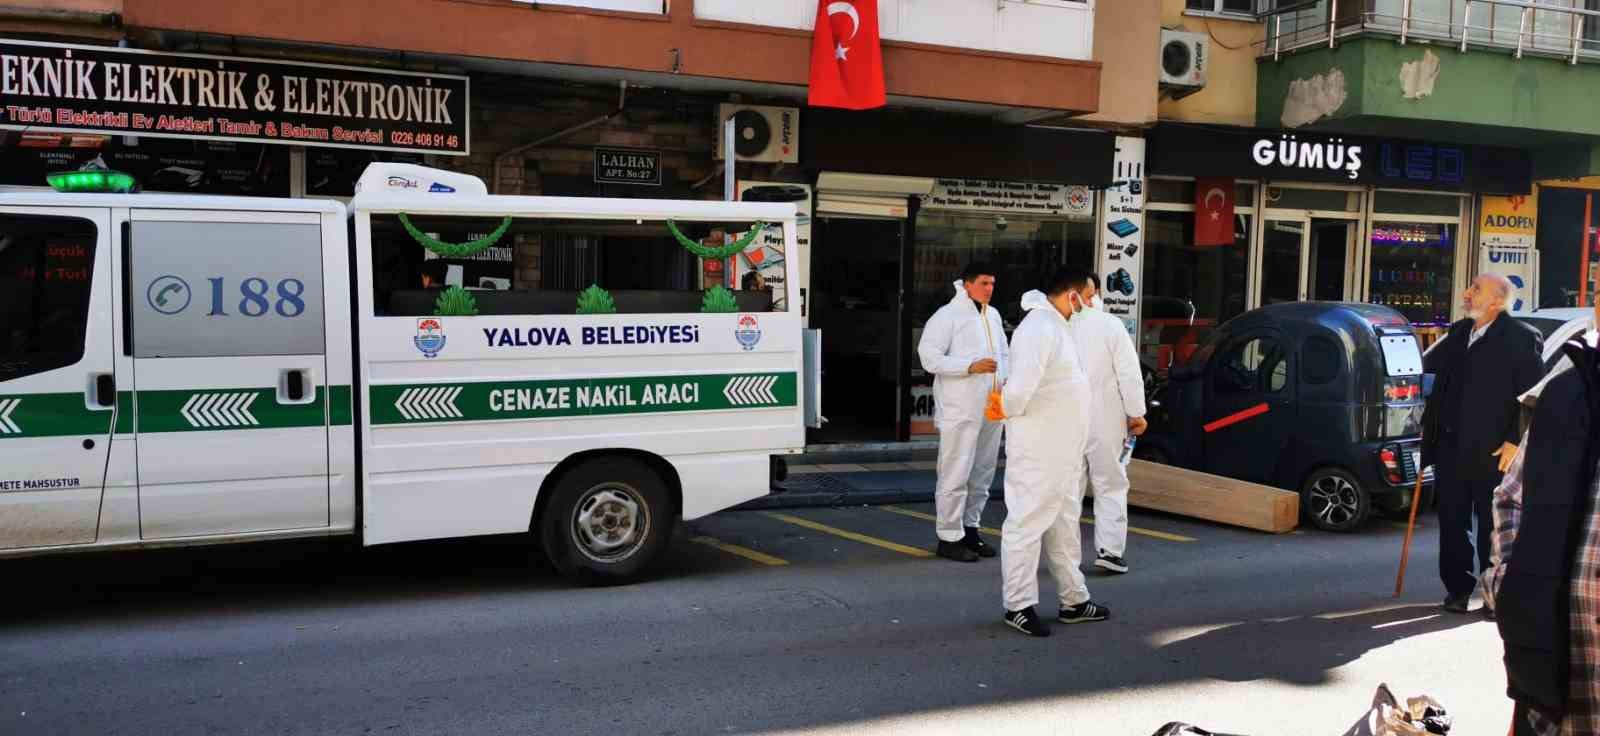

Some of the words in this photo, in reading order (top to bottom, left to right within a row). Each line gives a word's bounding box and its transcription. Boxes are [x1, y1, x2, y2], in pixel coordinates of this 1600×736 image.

[0, 49, 97, 100] EKNİK
[104, 61, 249, 109] ELEKTRİK
[254, 73, 277, 112] &
[283, 75, 453, 124] ELEKTRONİK
[6, 105, 52, 123] Türlü
[56, 108, 128, 128] Elektrikli
[132, 113, 153, 129] Ev
[157, 114, 213, 133] Aletleri
[218, 118, 261, 136] Tamir
[265, 121, 277, 136] &
[281, 122, 328, 140] Bakım
[332, 126, 384, 144] Servisi
[391, 130, 413, 144] 0226
[415, 132, 432, 146] 408
[433, 132, 445, 146] 91
[602, 154, 655, 169] LALHAN
[1253, 134, 1362, 179] GÜMÜŞ
[1381, 143, 1464, 182] LED
[1484, 214, 1535, 228] ADOPEN
[206, 277, 305, 317] 188
[483, 327, 571, 346] YALOVA
[489, 387, 570, 411] CENAZE
[642, 383, 699, 405] ARACI
[24, 478, 80, 489] MAHSUSTUR
